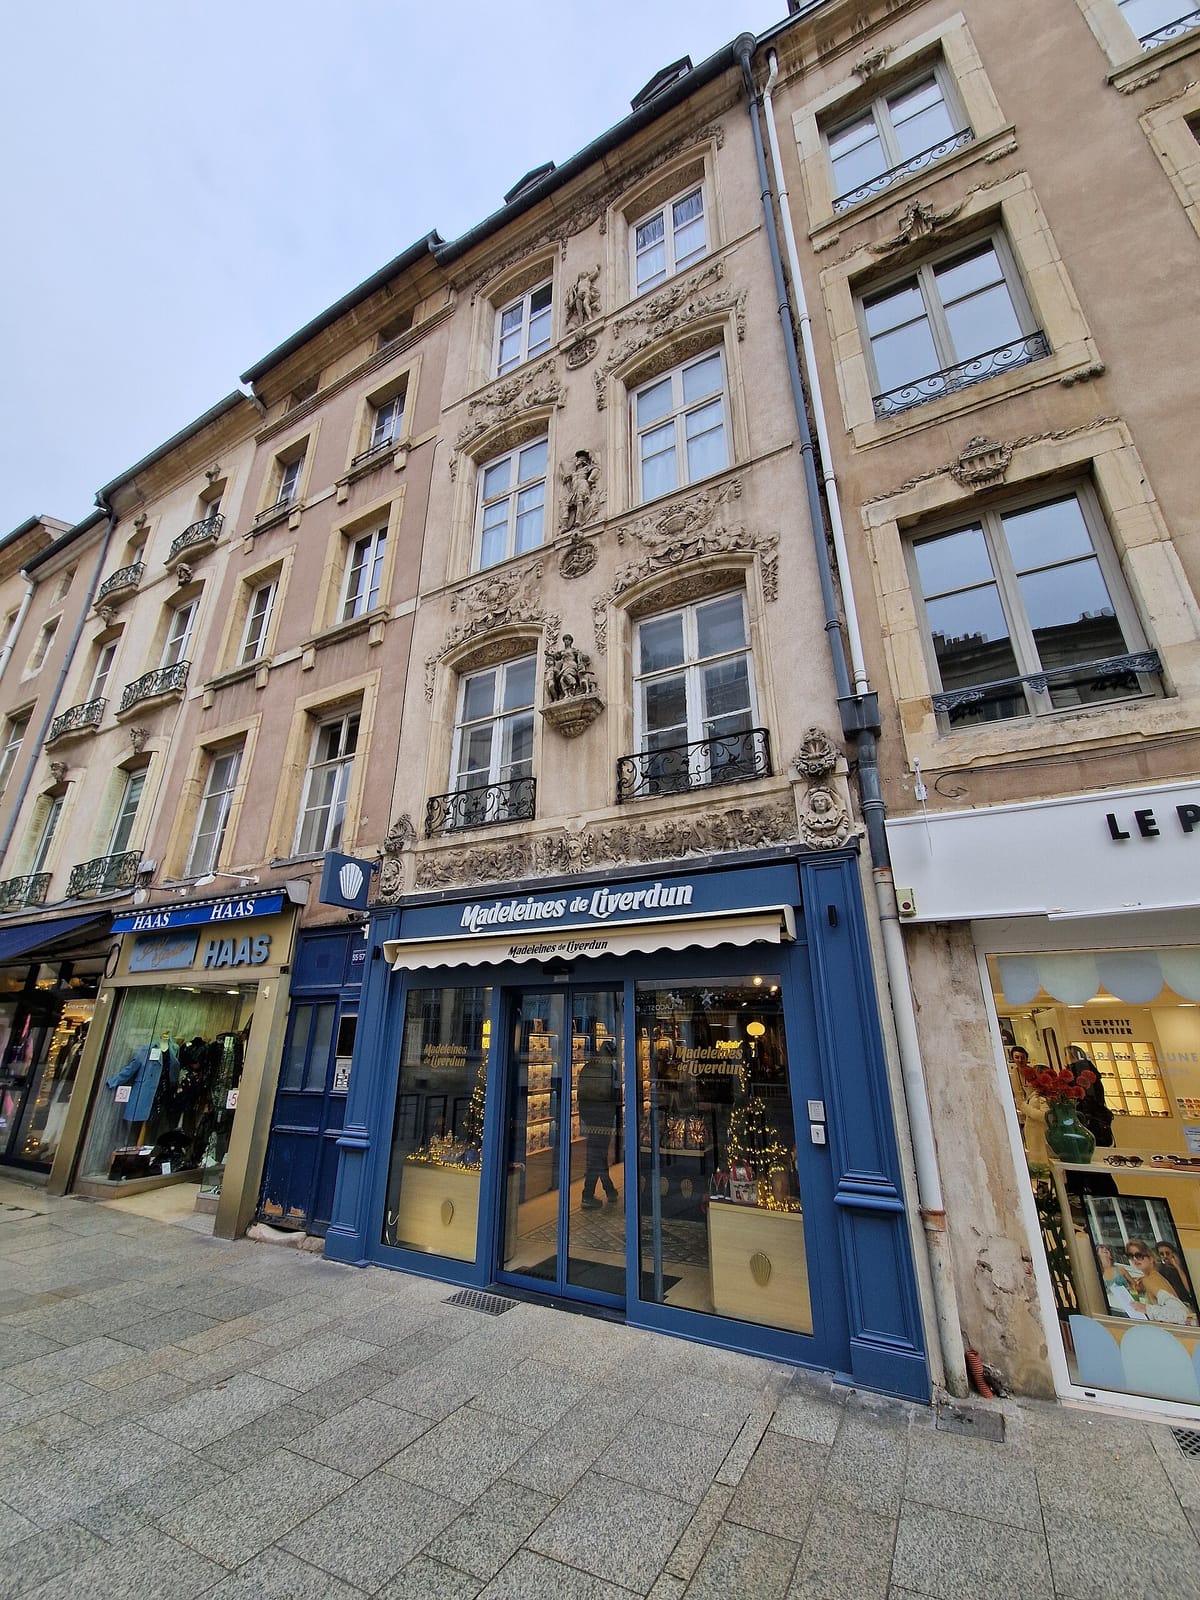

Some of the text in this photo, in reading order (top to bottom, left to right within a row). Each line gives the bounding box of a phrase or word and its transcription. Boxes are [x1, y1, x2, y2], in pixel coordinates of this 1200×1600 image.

[1106, 809, 1160, 840] LE
[210, 899, 256, 920] HAAS
[460, 883, 693, 932] Madeleines de Liverdun
[132, 912, 171, 930] HAAS
[203, 935, 271, 968] HAAS
[508, 943, 557, 958] Madeleines
[566, 940, 608, 953] Liverdun
[1083, 1027, 1133, 1035] LUNETIER
[423, 1043, 468, 1057] Madeleines
[431, 1054, 466, 1069] Liverdun
[677, 1060, 743, 1077] de Liverdun
